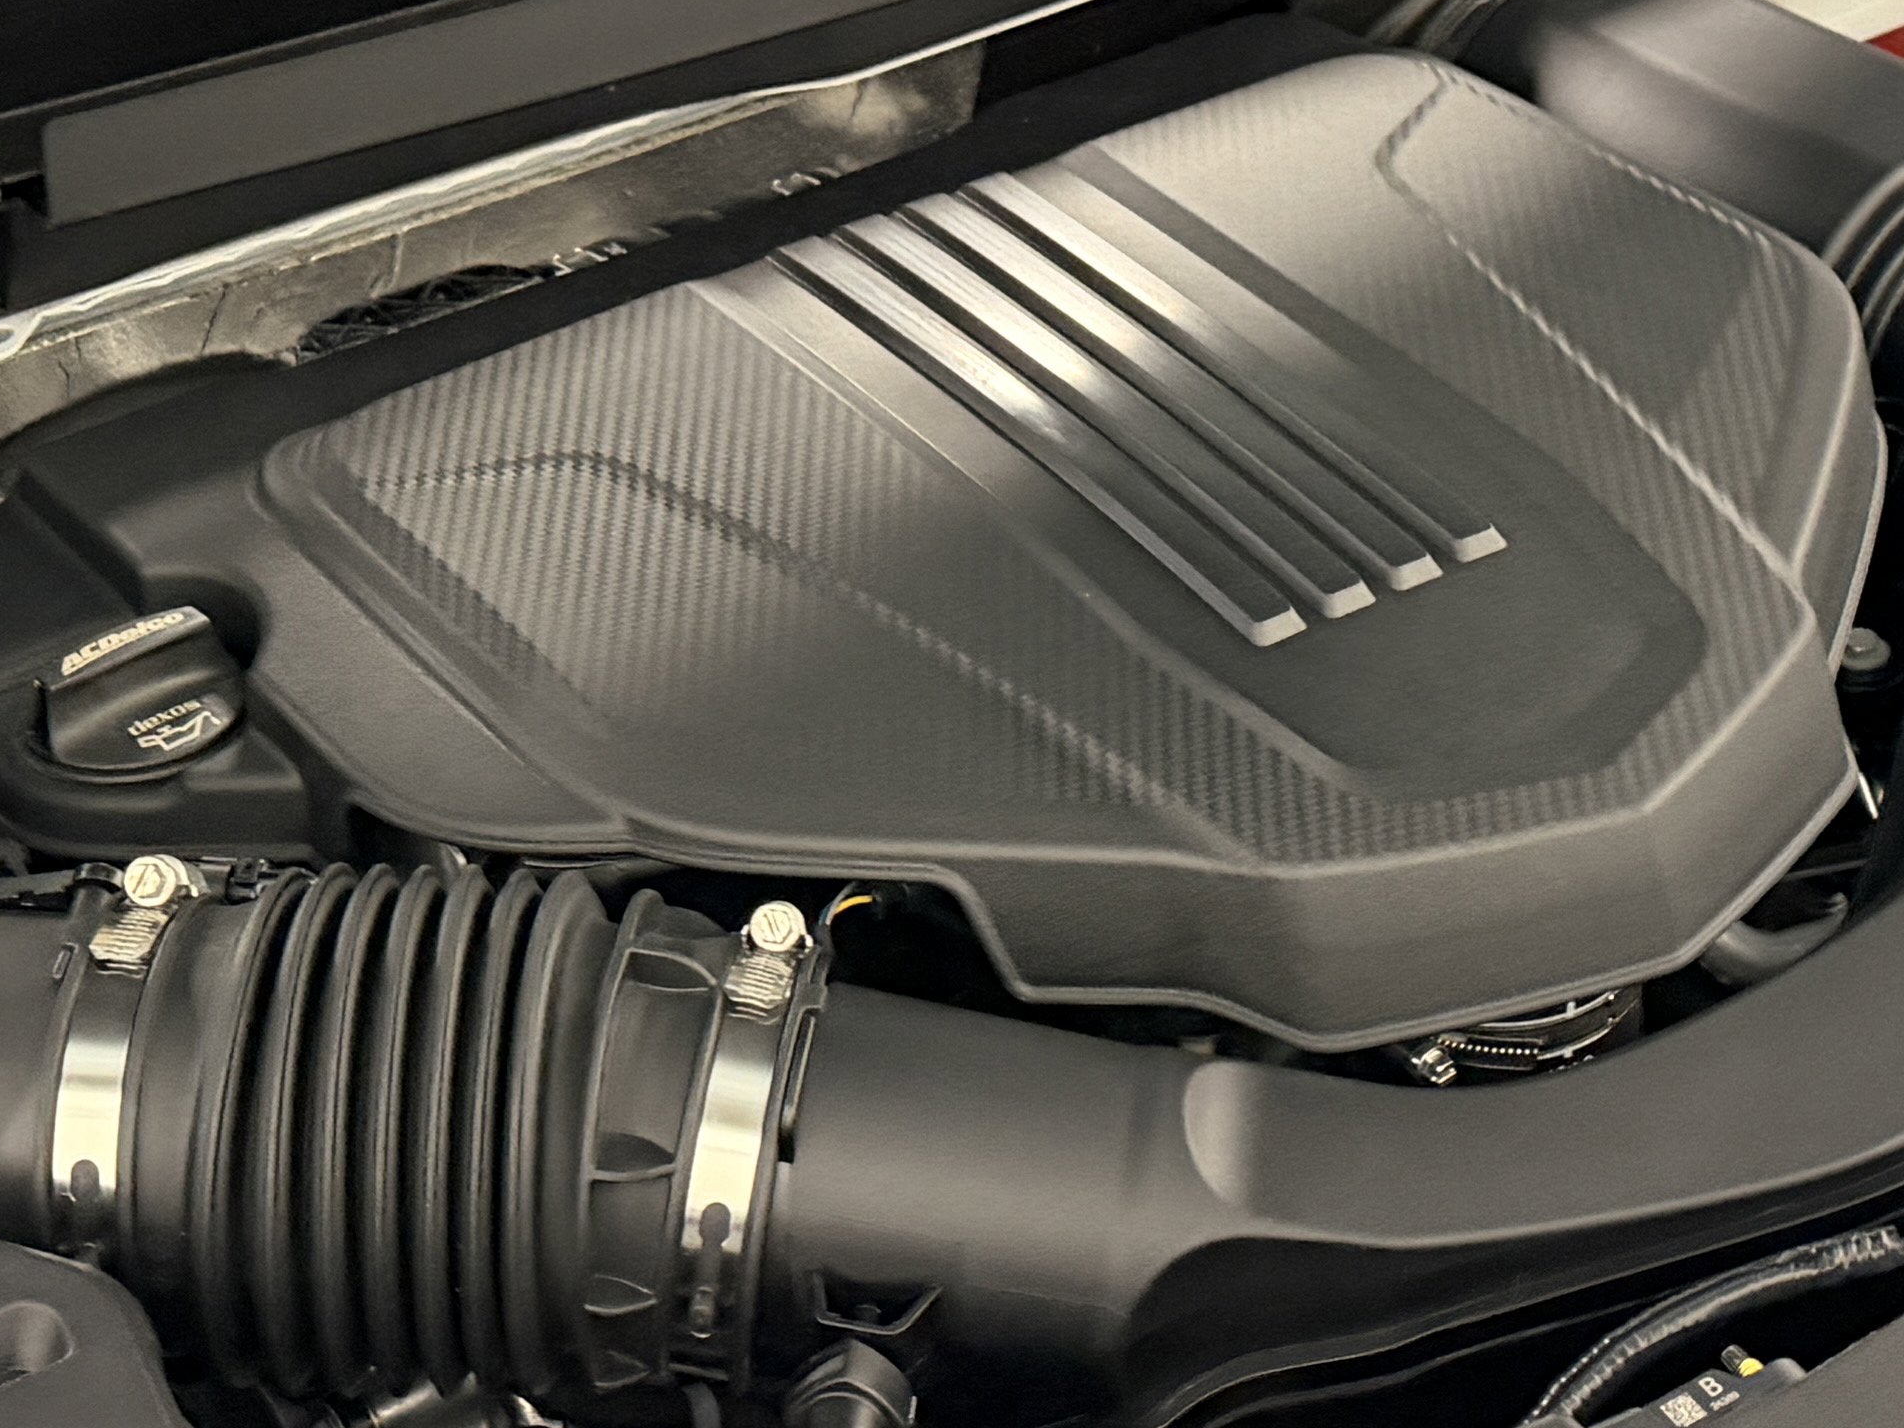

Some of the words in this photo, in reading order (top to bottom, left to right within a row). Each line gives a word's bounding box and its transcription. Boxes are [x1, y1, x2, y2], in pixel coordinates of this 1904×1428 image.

[61, 612, 185, 676] ACDelco
[127, 699, 203, 736] dexos
[1698, 1376, 1724, 1398] B
